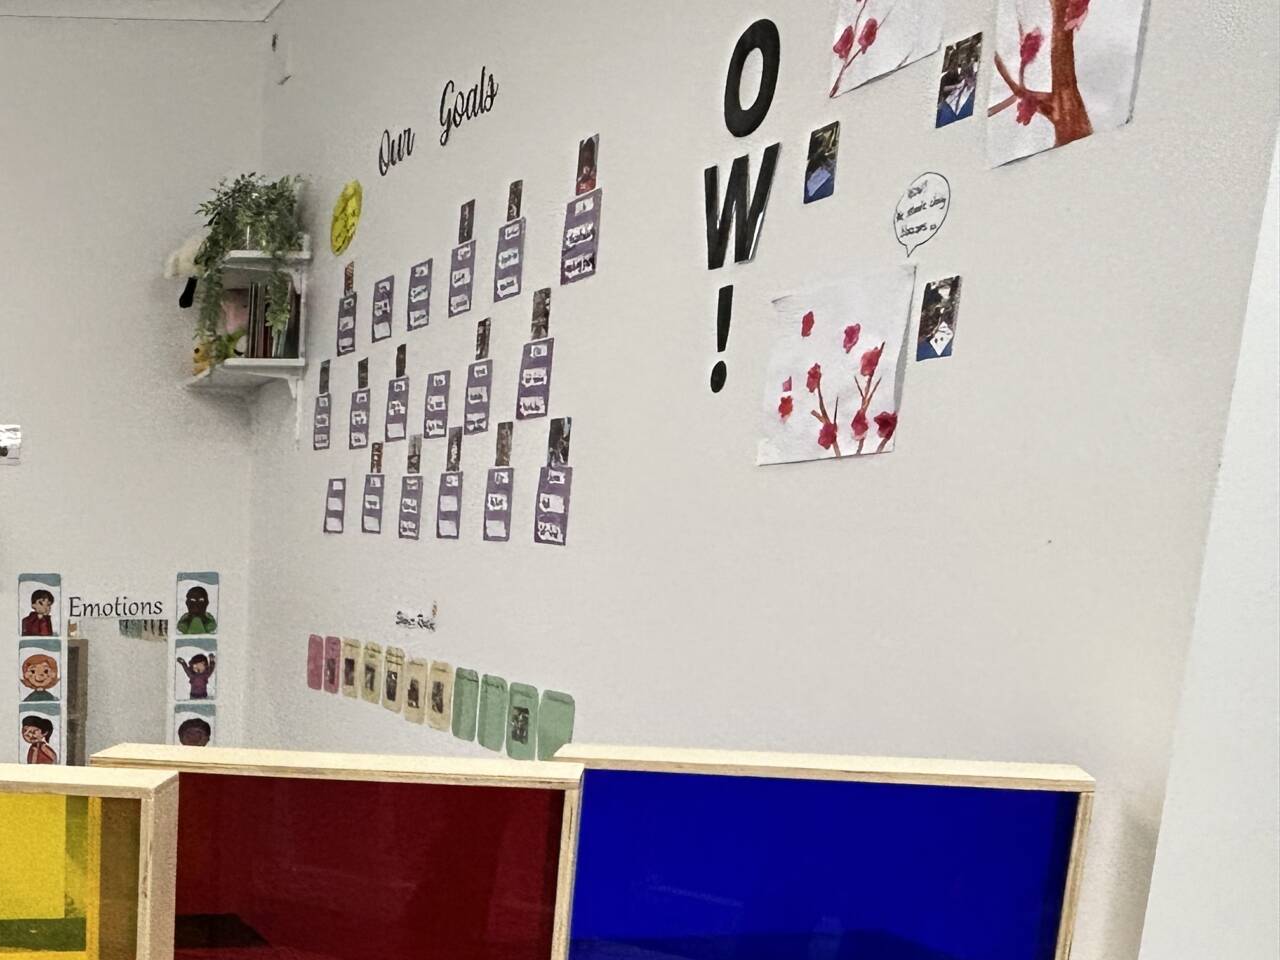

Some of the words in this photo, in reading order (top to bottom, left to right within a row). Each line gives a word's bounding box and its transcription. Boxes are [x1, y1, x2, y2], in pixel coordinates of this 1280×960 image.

[379, 127, 415, 176] Our
[439, 66, 499, 146] Goals
[68, 596, 163, 617] Emotions
